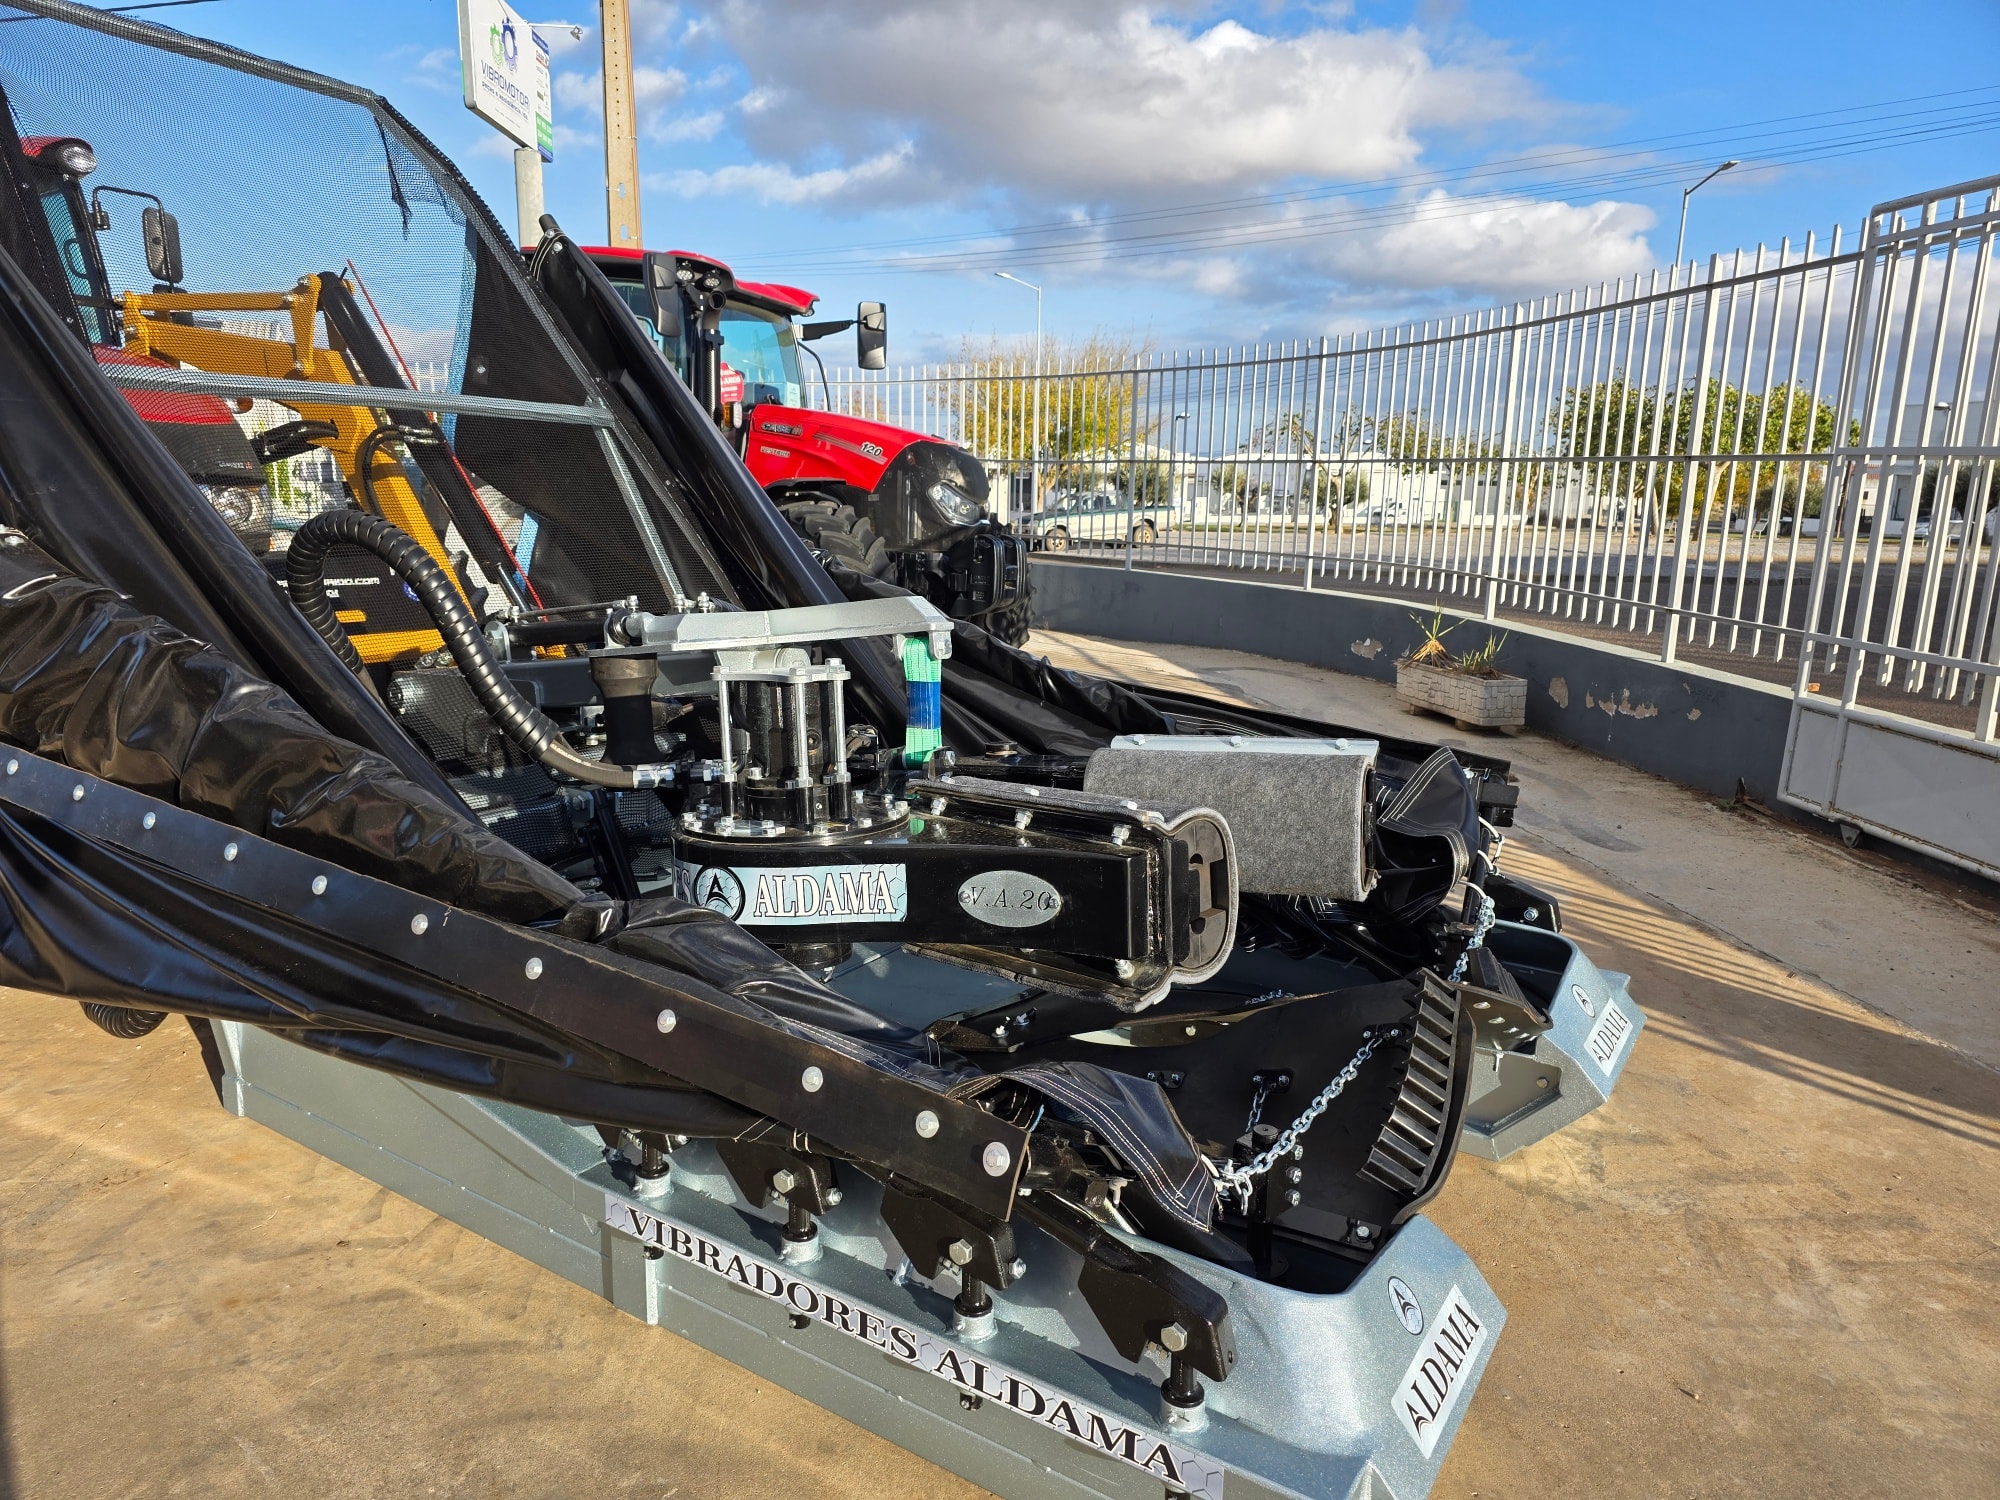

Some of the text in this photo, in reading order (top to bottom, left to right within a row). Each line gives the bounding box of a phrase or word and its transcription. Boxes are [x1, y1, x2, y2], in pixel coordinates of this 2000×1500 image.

[481, 59, 529, 108] VIBROMOTOR
[761, 422, 791, 434] CASE
[861, 441, 883, 457] 120
[753, 871, 896, 917] ALDAMA
[1592, 1008, 1628, 1064] ALDAMA
[626, 1206, 1185, 1485] VIBRADORES ALDAMA
[1405, 1303, 1480, 1440] ALDAMA
